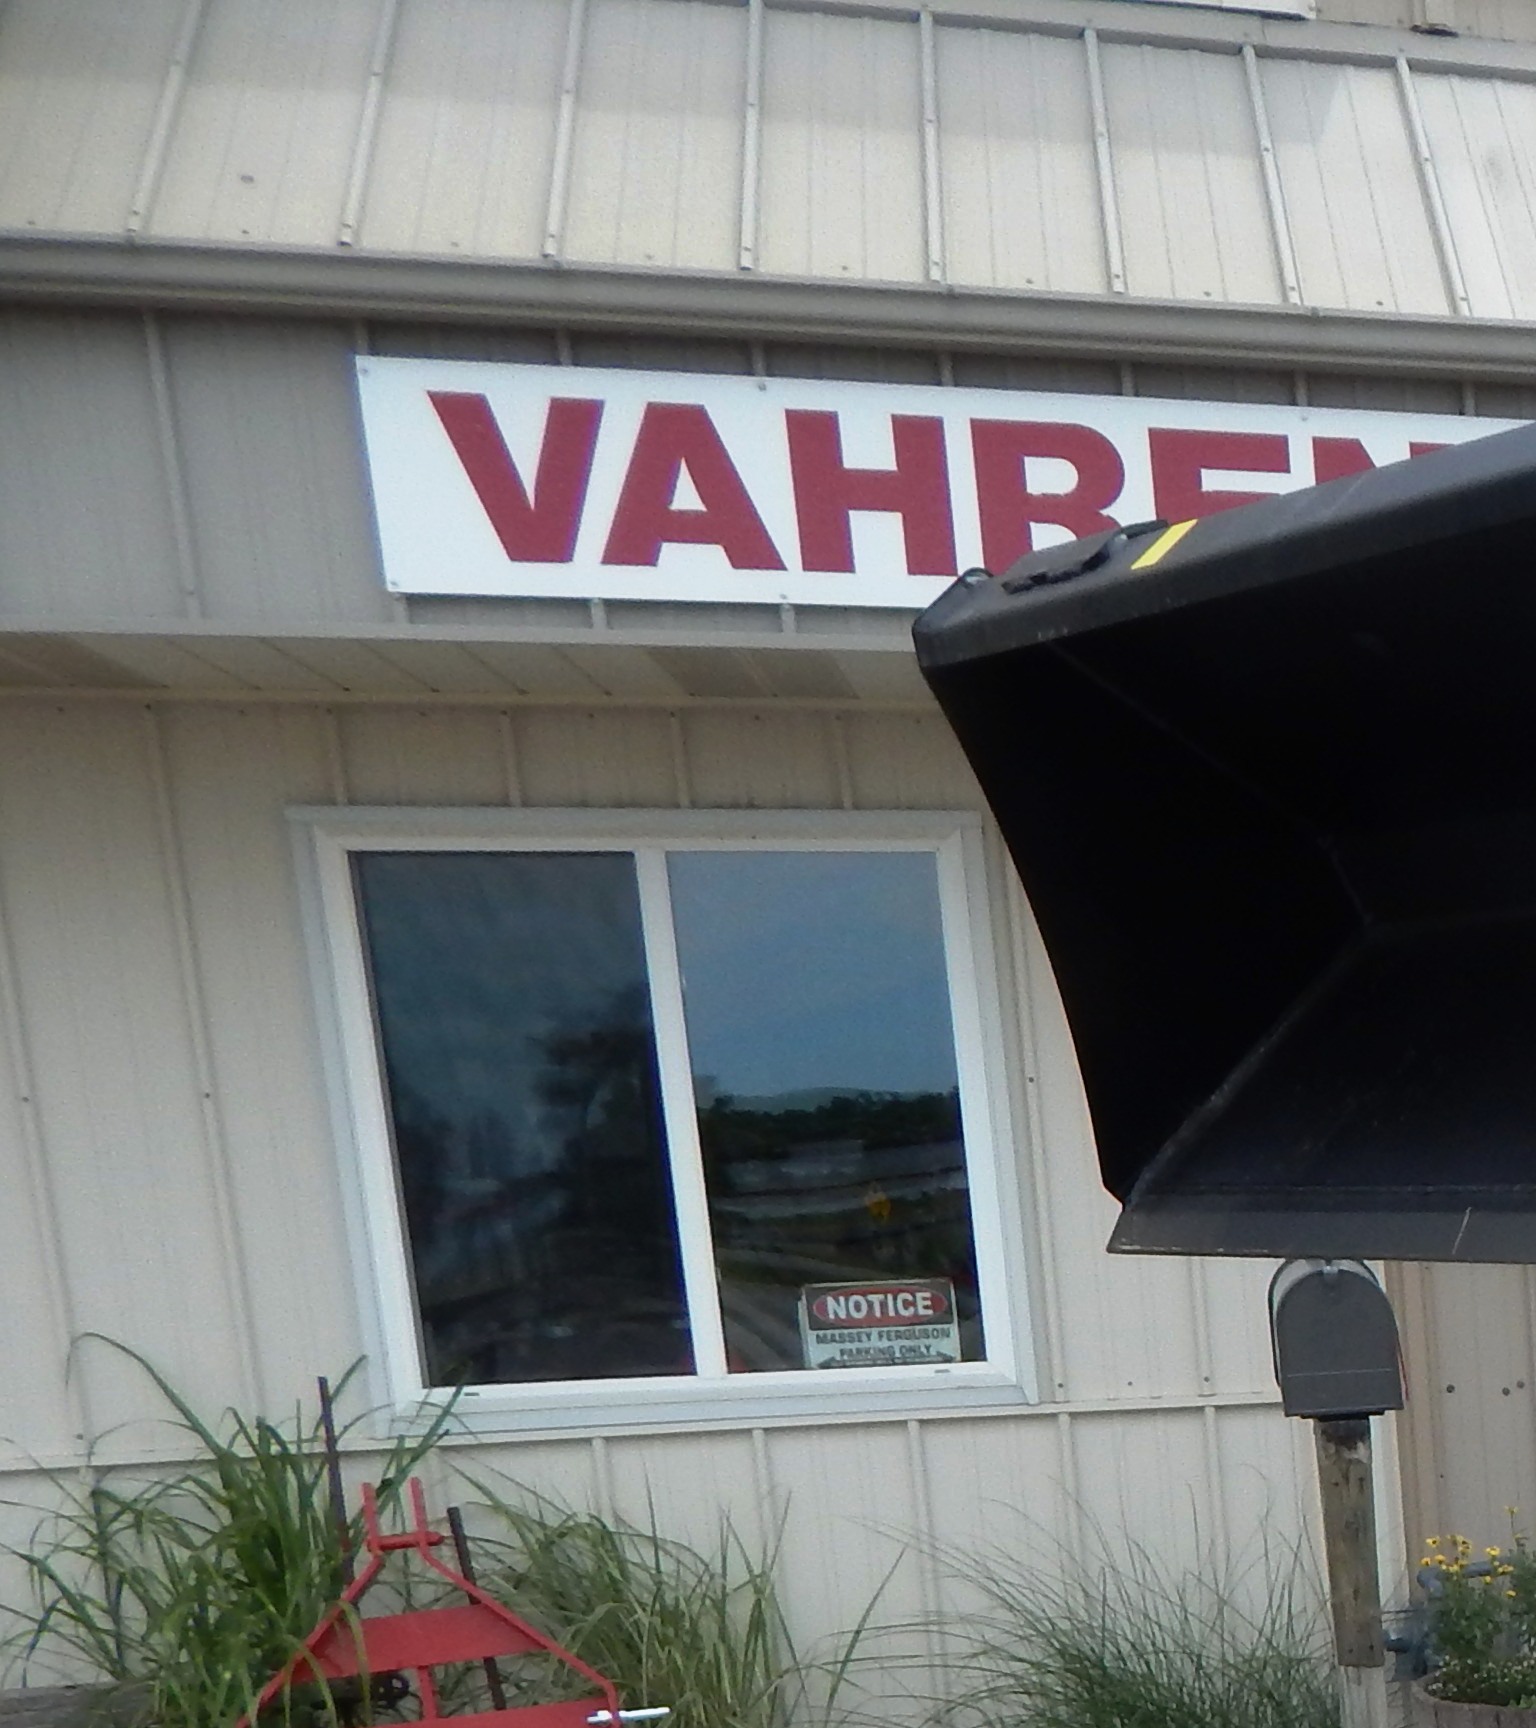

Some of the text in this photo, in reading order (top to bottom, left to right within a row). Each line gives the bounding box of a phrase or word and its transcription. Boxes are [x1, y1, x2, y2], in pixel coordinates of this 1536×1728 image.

[426, 389, 1455, 577] VAHRE
[826, 1291, 934, 1320] NOTICE
[815, 1327, 951, 1345] MASSEY FERGUSON
[839, 1343, 932, 1358] PARKING ONLY
